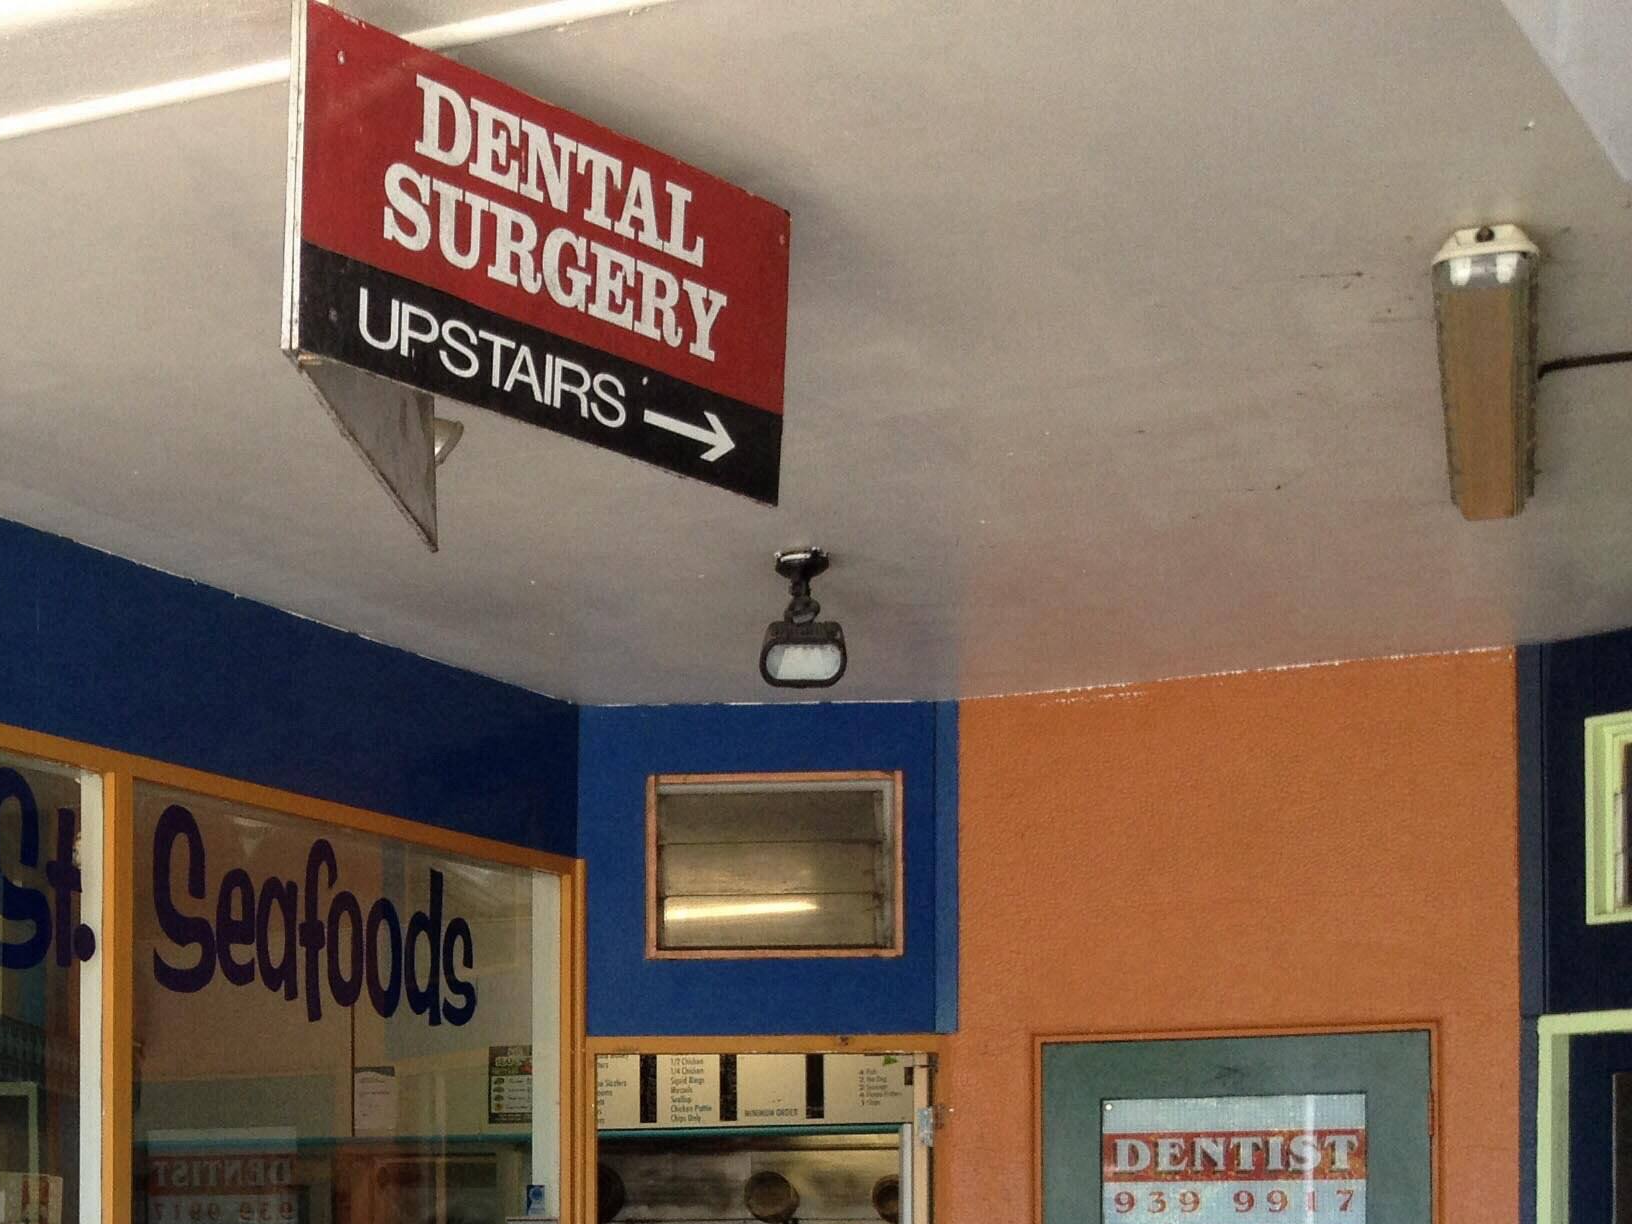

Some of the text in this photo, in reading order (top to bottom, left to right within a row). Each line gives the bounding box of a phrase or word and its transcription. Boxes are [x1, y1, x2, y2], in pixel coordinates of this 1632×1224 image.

[414, 73, 704, 268] DENTAL
[383, 162, 728, 363] SURGERY
[358, 287, 626, 429] UPSTAIRS
[153, 804, 478, 1027] Seafoods
[1114, 1134, 1360, 1174] DENTIST
[1114, 1189, 1202, 1215] 939
